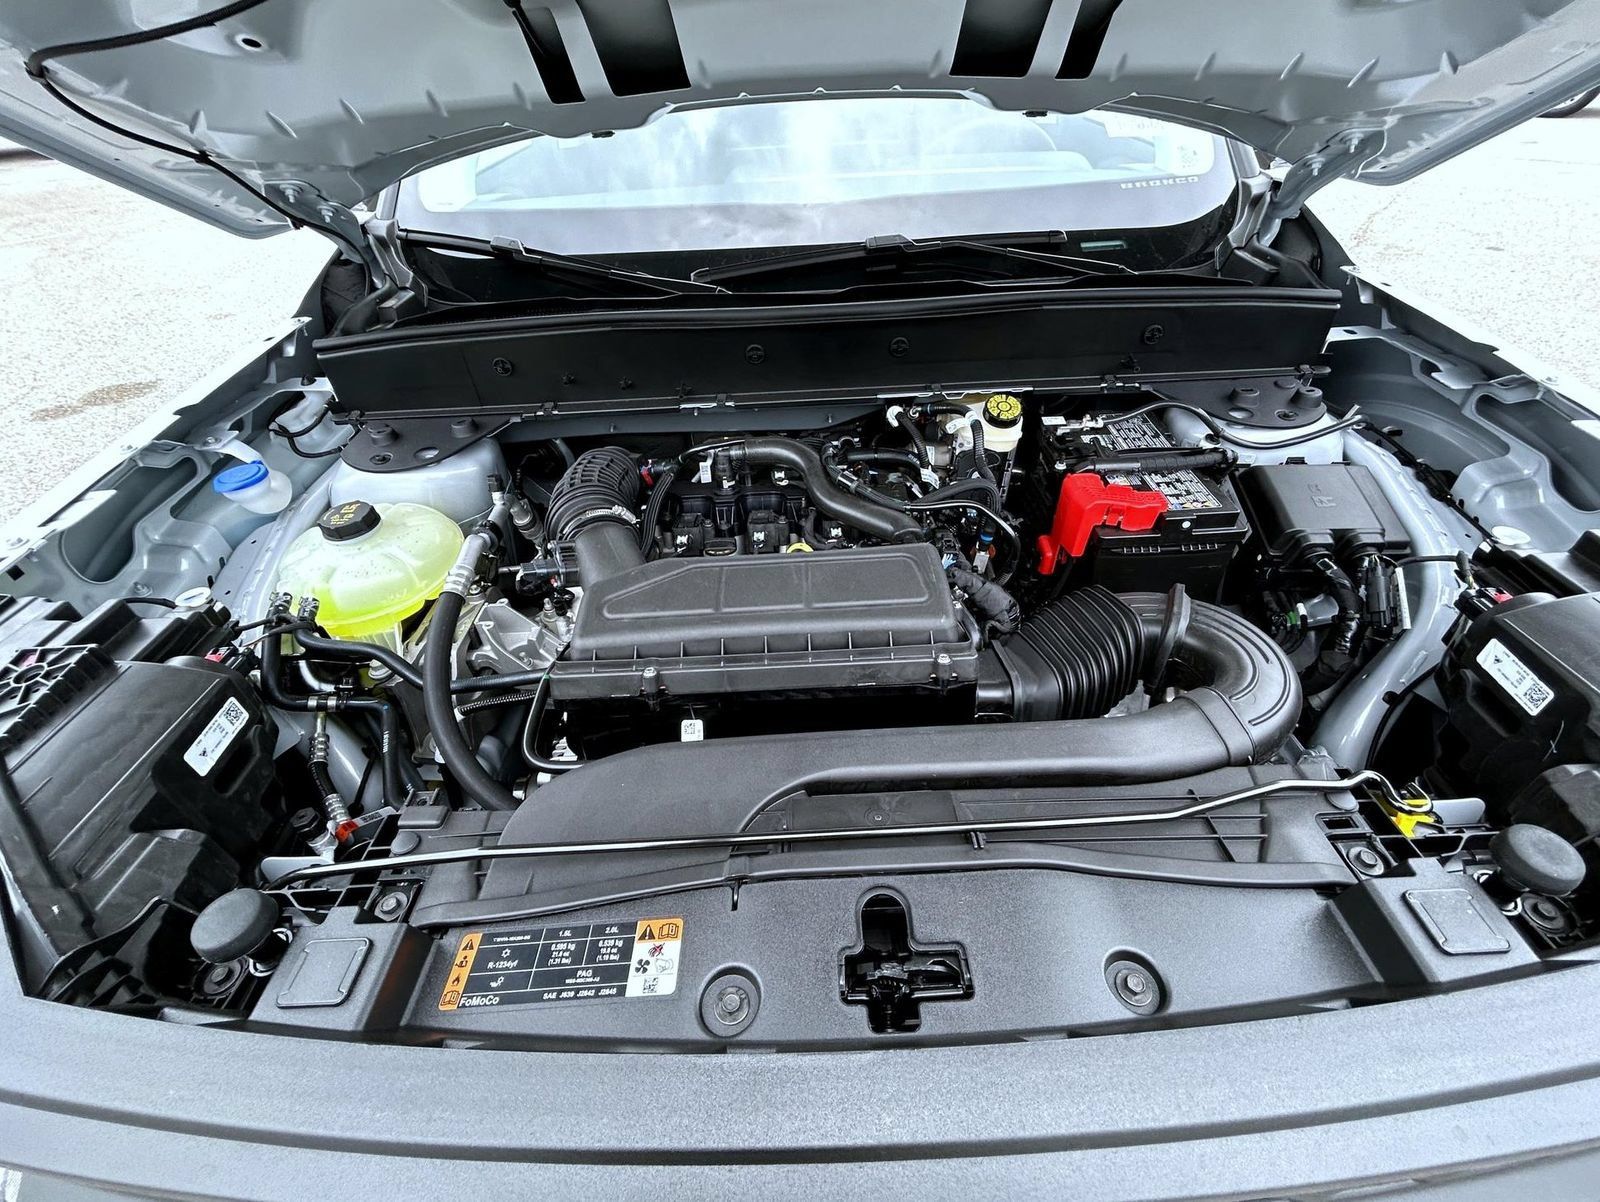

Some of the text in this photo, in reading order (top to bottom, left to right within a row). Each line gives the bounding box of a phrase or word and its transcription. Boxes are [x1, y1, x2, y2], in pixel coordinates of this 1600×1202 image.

[1120, 176, 1199, 189] BRONCO
[567, 943, 576, 951] kg
[615, 939, 623, 947] kg
[459, 995, 499, 1007] FoMoCo
